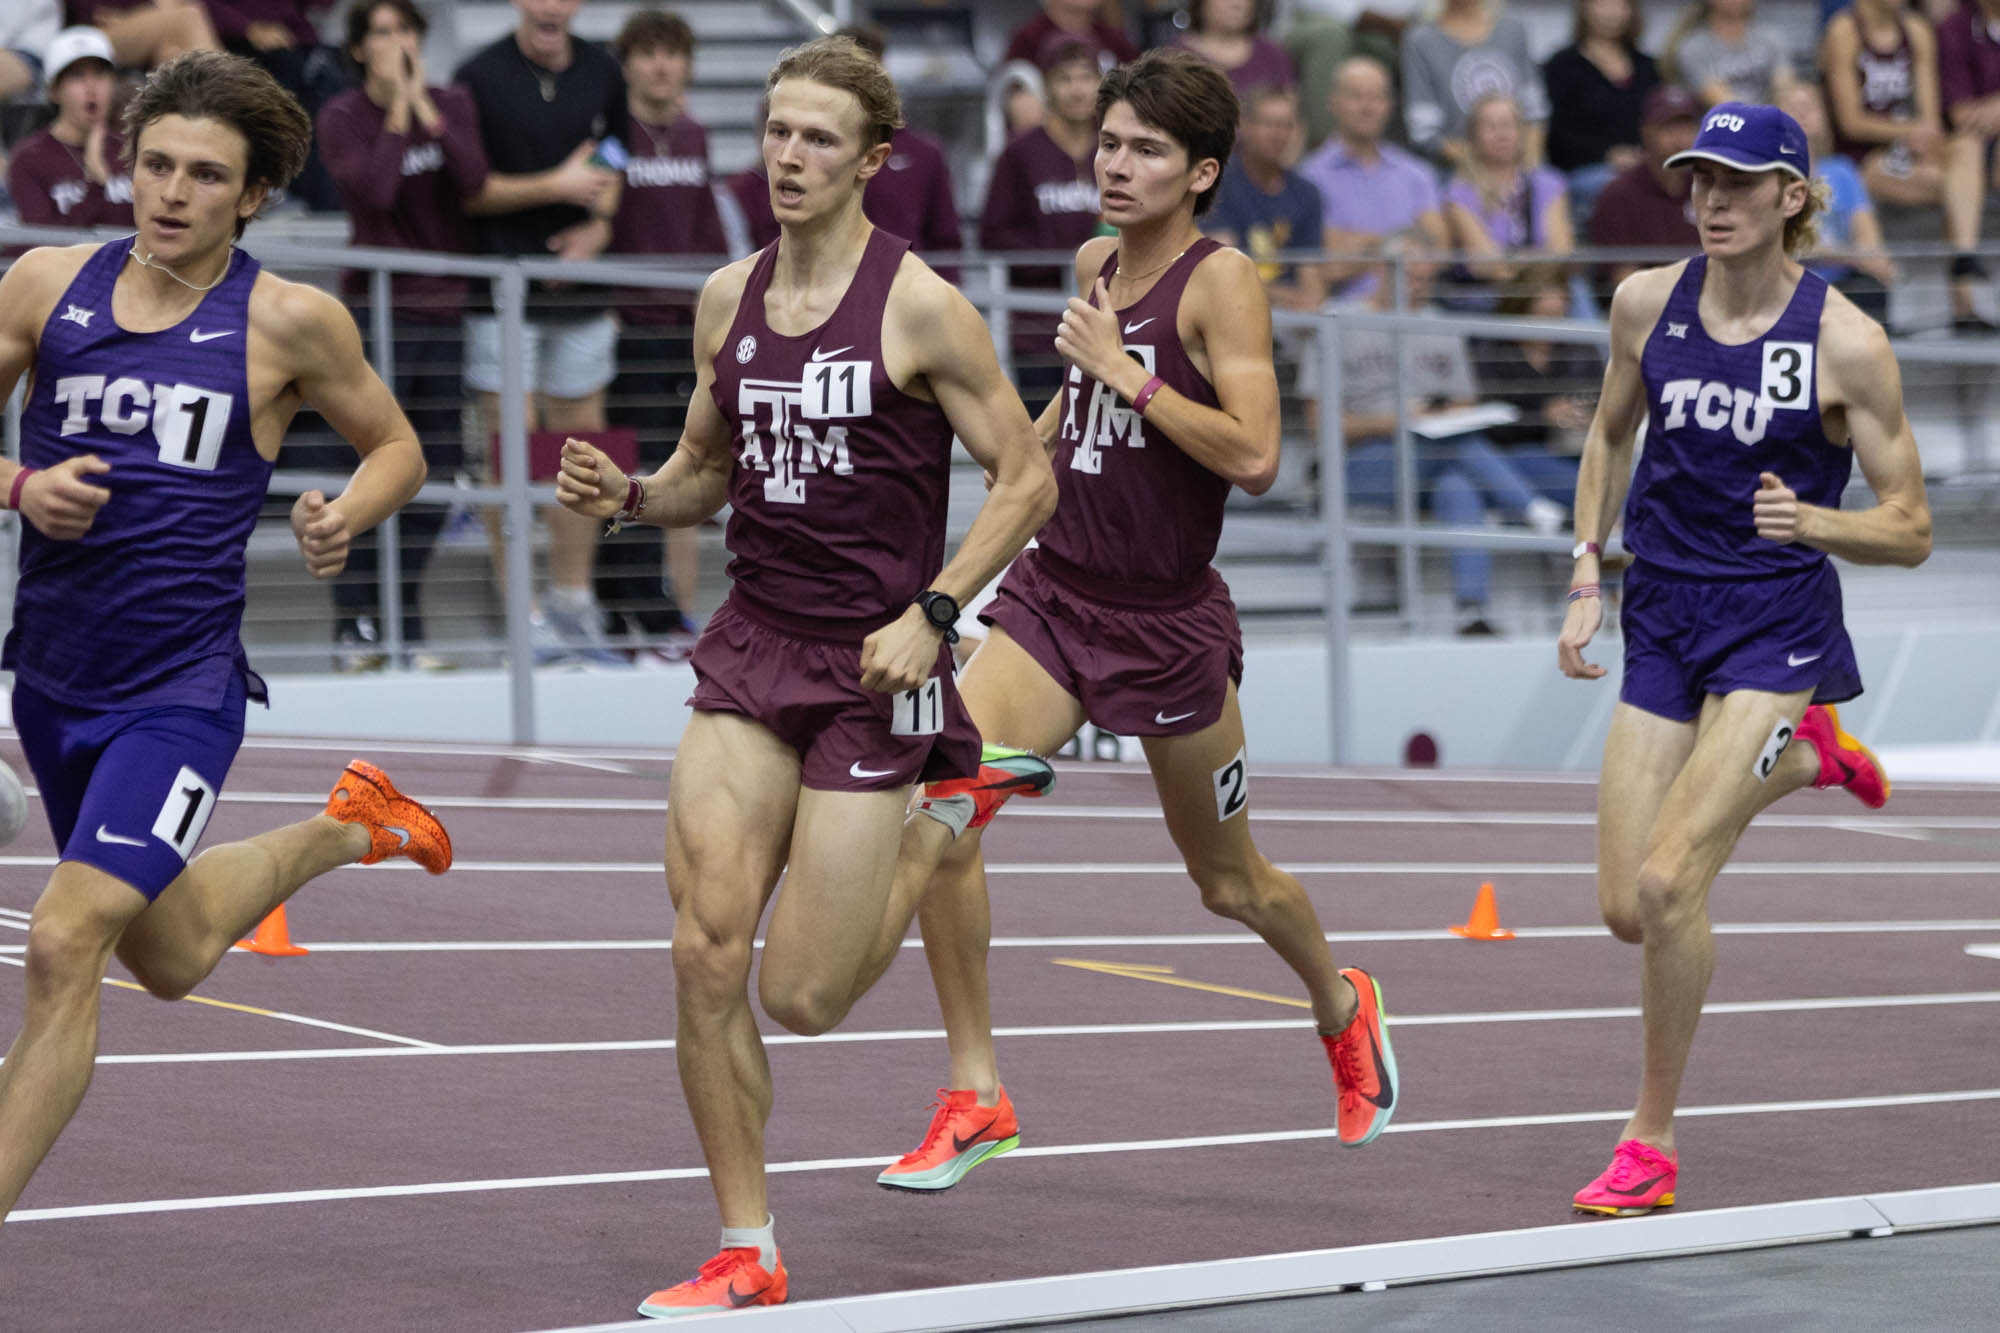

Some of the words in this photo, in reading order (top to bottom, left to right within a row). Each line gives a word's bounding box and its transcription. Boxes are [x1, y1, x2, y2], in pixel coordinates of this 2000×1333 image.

[1704, 113, 1746, 133] TCU
[737, 337, 756, 363] SEC
[1767, 347, 1802, 403] 3
[815, 365, 856, 415] 11
[1660, 378, 1776, 447] TCU
[179, 396, 210, 463] 1
[905, 681, 937, 732] 11
[1761, 727, 1792, 778] 3
[1220, 759, 1246, 817] 2
[173, 786, 205, 848] 1
